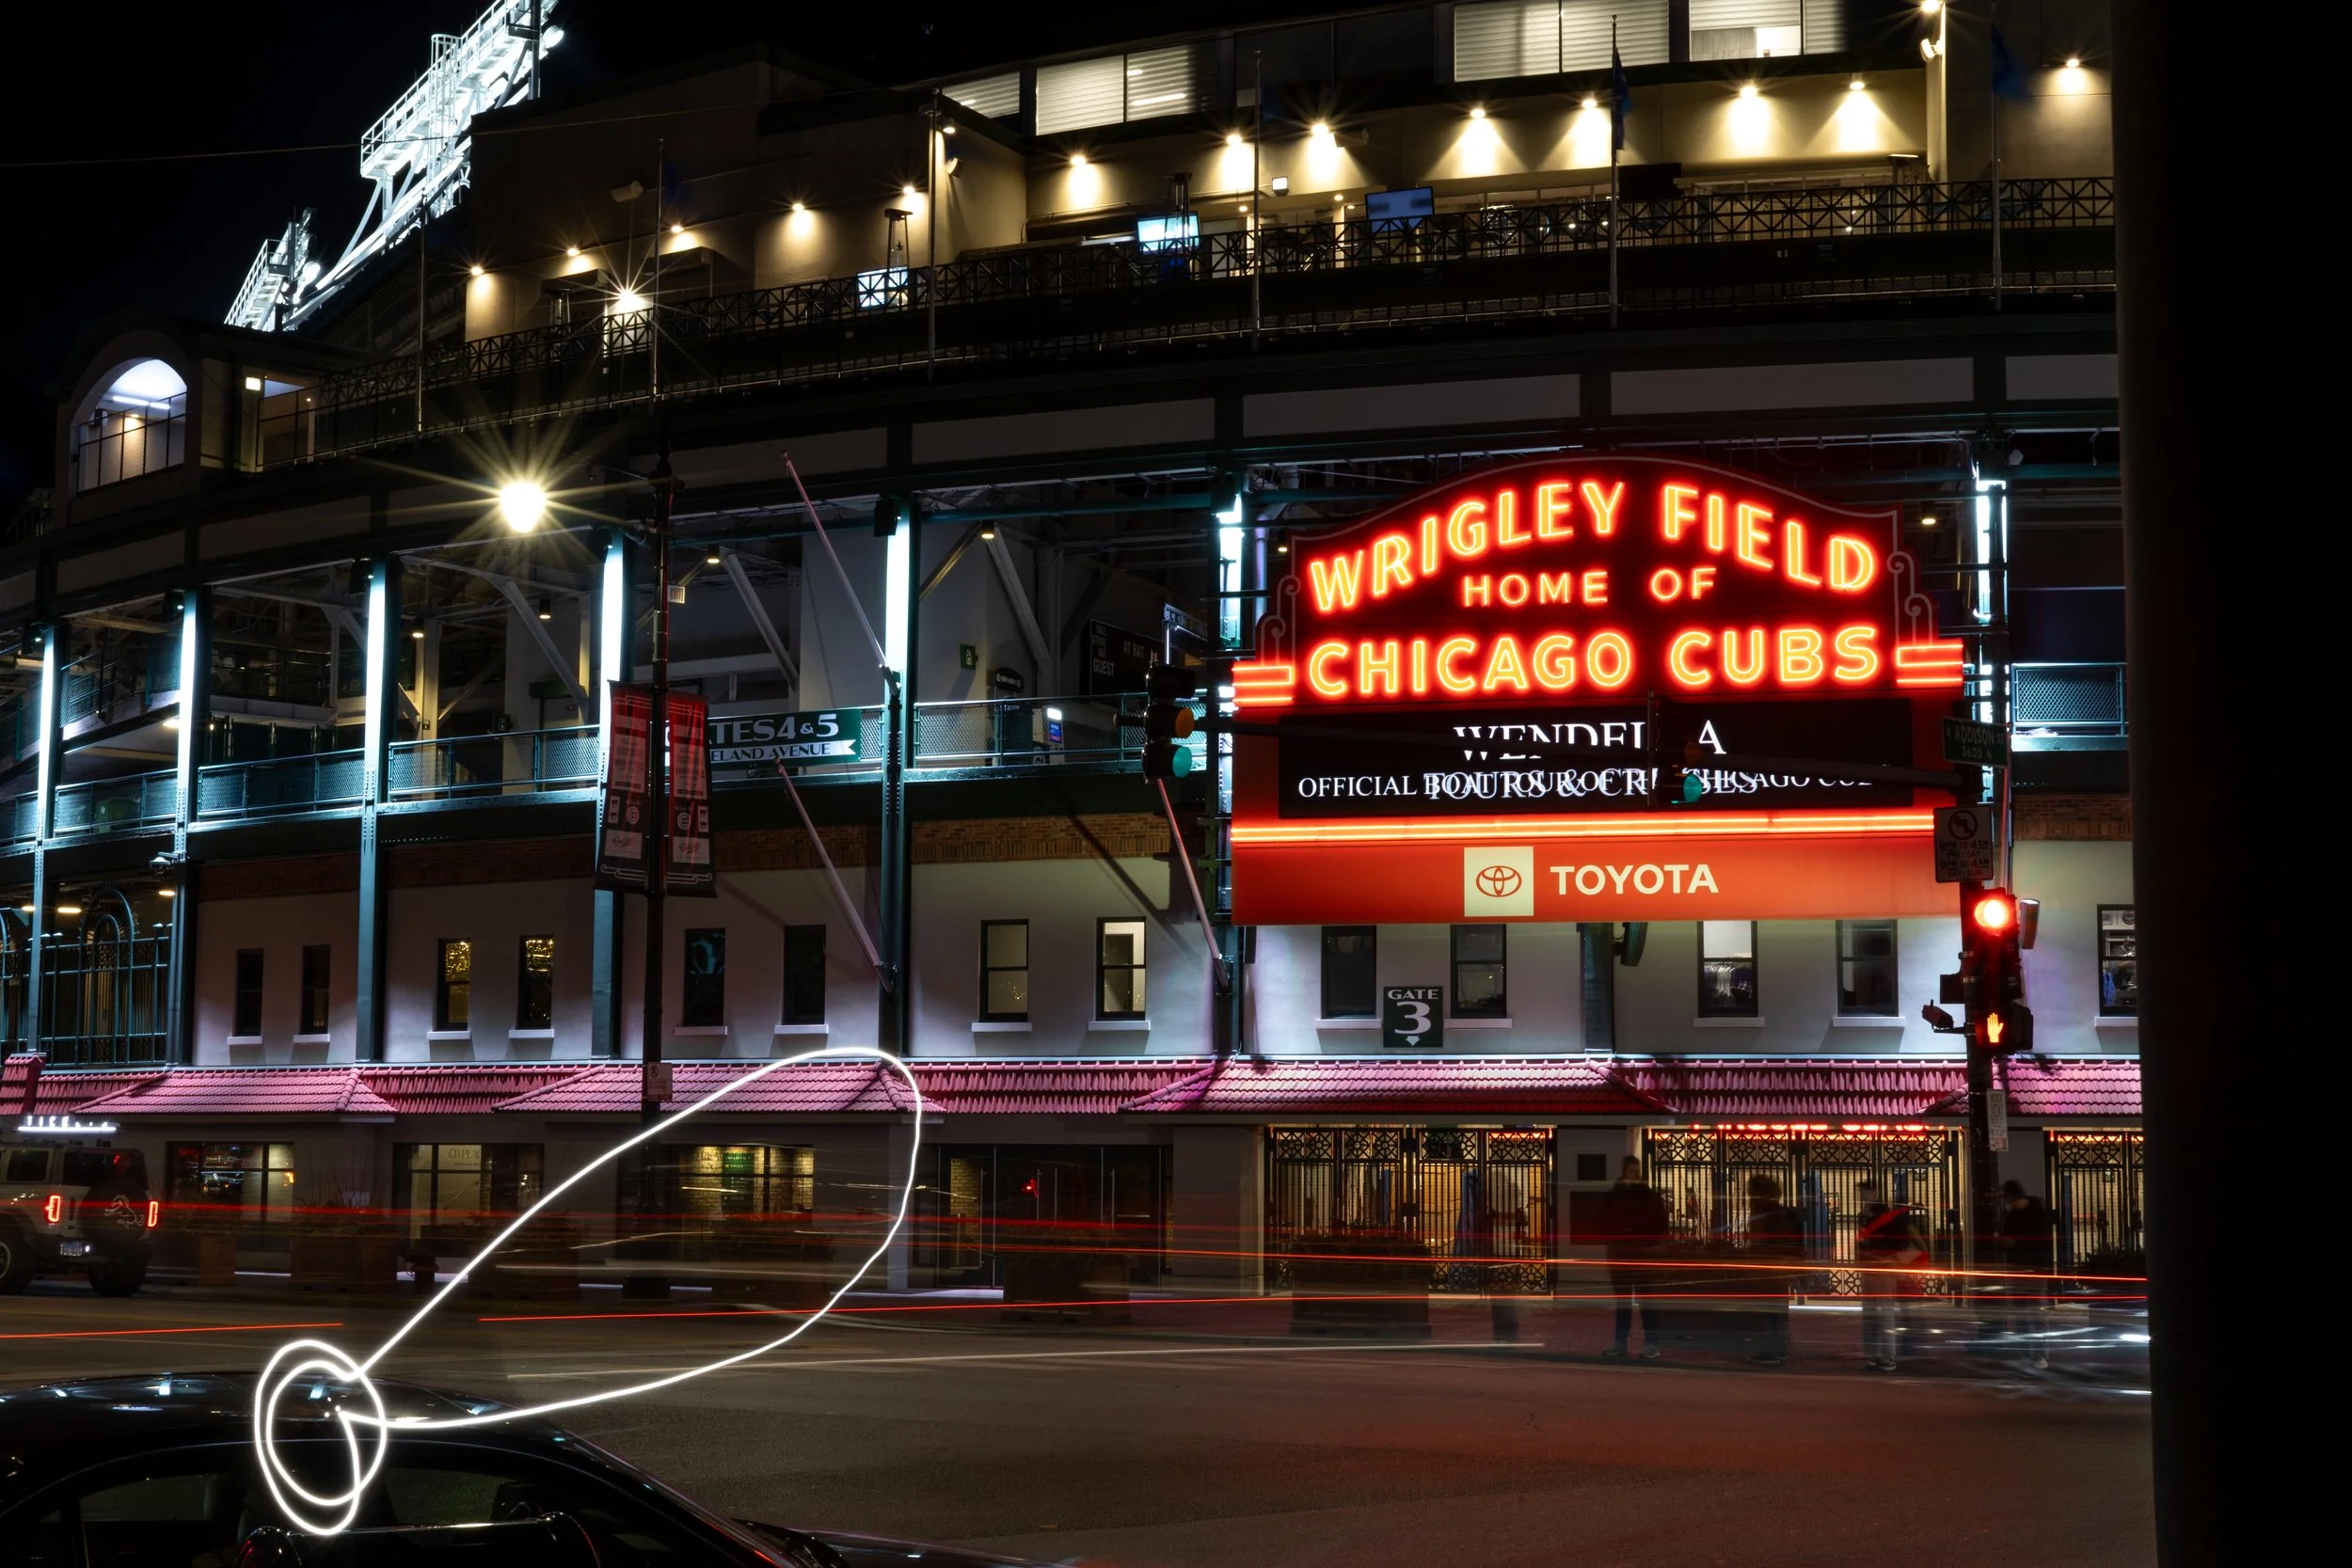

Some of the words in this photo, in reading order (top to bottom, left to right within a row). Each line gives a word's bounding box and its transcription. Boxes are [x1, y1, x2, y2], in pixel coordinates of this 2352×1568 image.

[1309, 479, 1627, 614] WRIGLEY
[1661, 482, 1877, 592] FIELD
[1463, 570, 1610, 609] HOME
[1649, 566, 1717, 602] OF
[1122, 640, 1133, 656] AT
[1133, 643, 1145, 659] BAT
[1093, 657, 1115, 678] GUEST
[1308, 631, 1634, 697] CHICAGO
[1669, 626, 1878, 687] CUBS
[799, 721, 815, 735] &
[816, 713, 840, 737] 5
[1954, 724, 1994, 746] ADDISON
[711, 747, 765, 763] ELAND
[768, 741, 832, 758] AVENUE
[1454, 720, 1727, 761] WENDELA
[1961, 745, 1983, 759] 3600
[1985, 748, 1993, 762] N
[1297, 775, 1418, 798] OFFICIAL
[1549, 863, 1720, 895] TOYOTA
[1387, 989, 1439, 1000] GATE
[1394, 1000, 1432, 1035] 3
